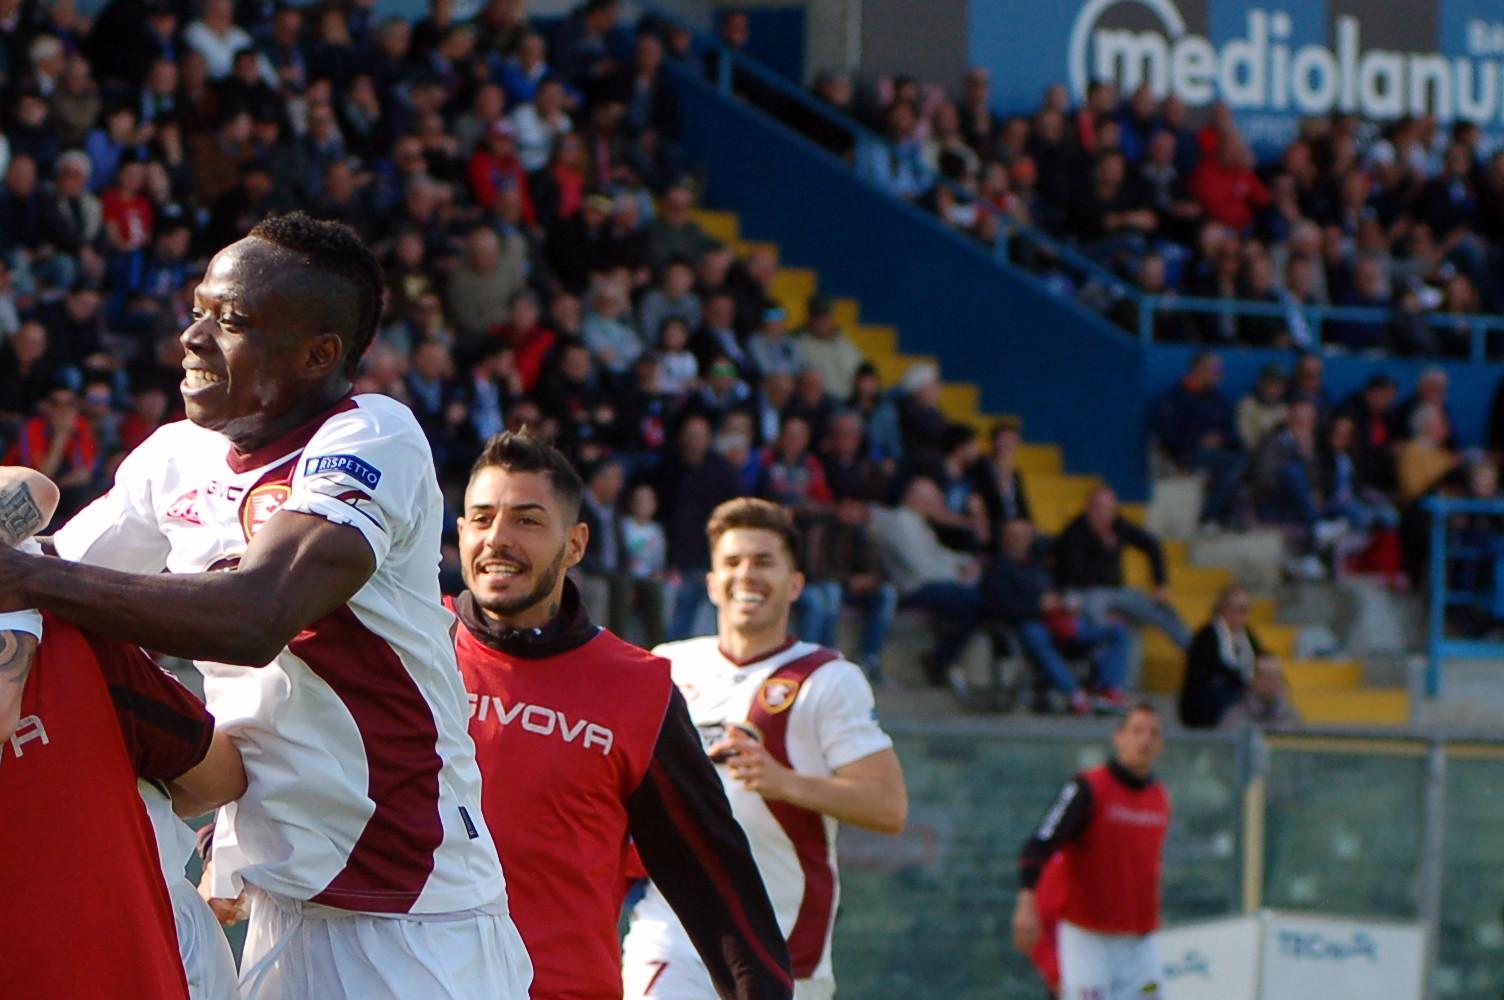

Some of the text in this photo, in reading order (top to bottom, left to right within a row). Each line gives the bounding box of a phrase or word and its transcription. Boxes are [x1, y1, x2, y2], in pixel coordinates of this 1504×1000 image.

[1094, 8, 1504, 123] mediolanu
[319, 457, 377, 484] RISPETTO
[644, 960, 669, 996] 7
